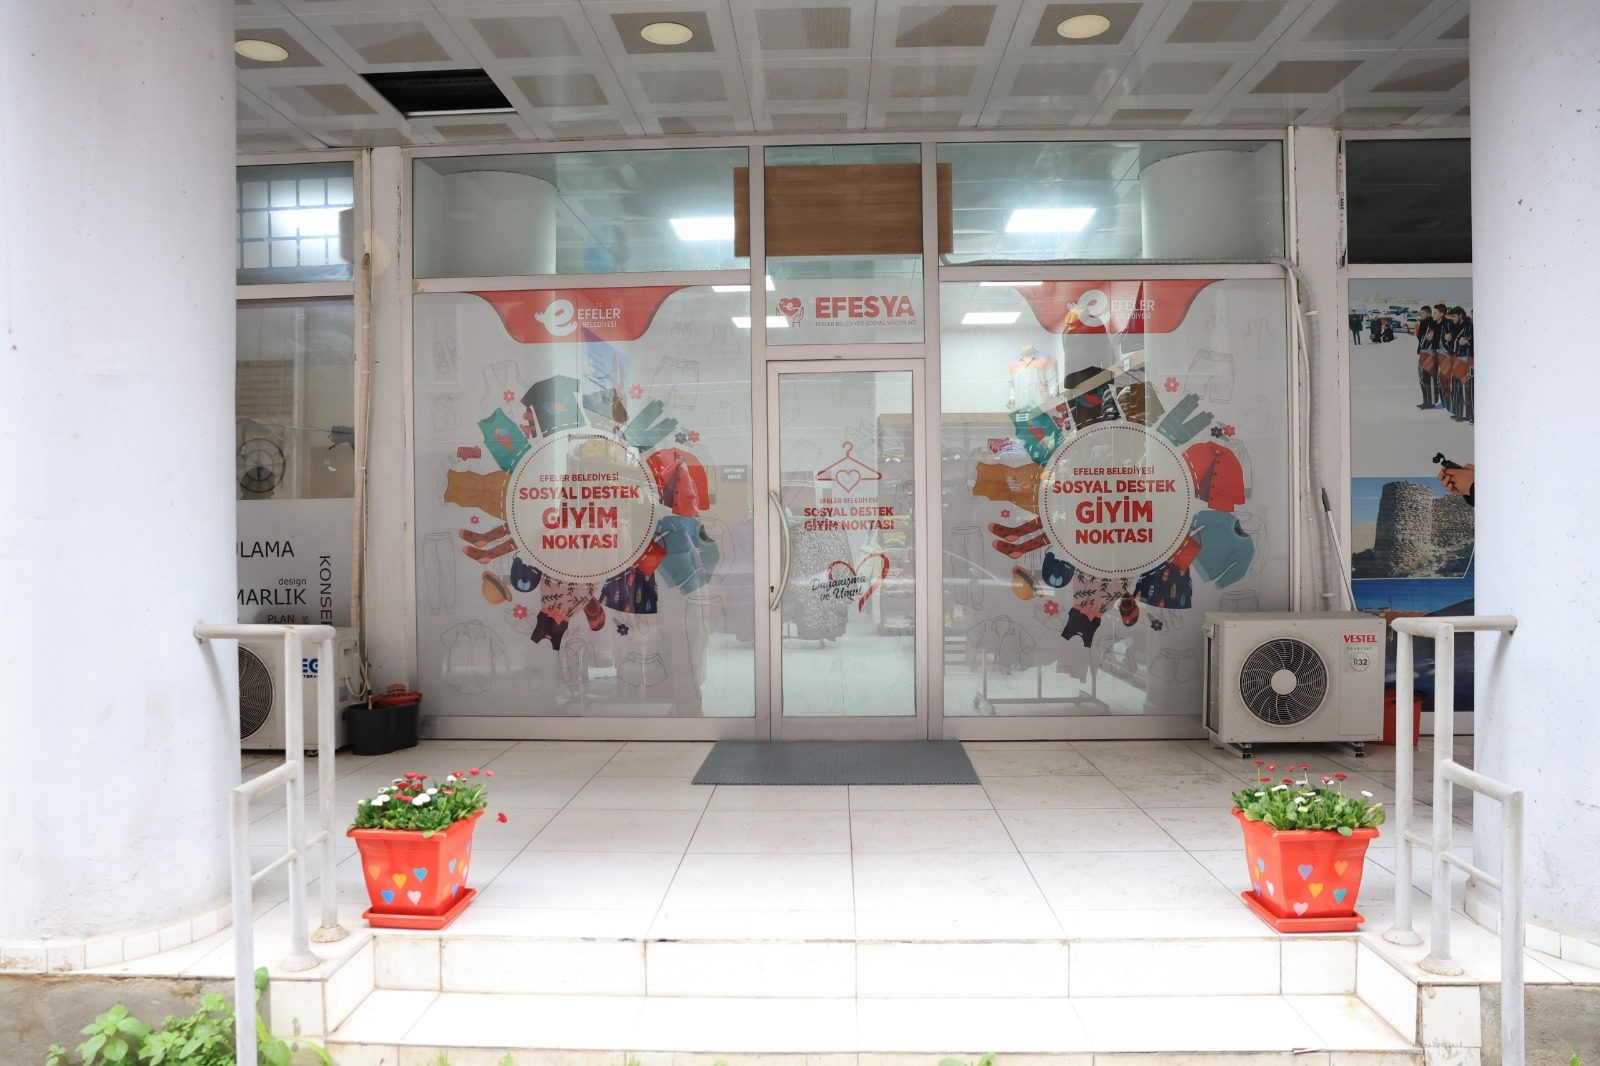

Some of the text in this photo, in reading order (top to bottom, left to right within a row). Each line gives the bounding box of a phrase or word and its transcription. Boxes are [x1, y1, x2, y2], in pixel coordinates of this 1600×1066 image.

[815, 295, 915, 318] EFESYA
[1111, 299, 1156, 311] EFELER
[577, 307, 621, 320] EFELER
[539, 471, 619, 482] EFELER BELEDİYESİ
[1073, 465, 1154, 476] EFELER BELEDİYESİ
[519, 485, 640, 500] SOSYAL DESTEK
[1052, 479, 1176, 494] SOSYAL DESTEK
[542, 502, 618, 530] GİYİM
[803, 506, 894, 517] SOSYAL DESTEK
[1075, 495, 1153, 524] GİYİM
[803, 518, 895, 532] GİYİM NOKTASI
[542, 533, 618, 550] NOKTASI
[1075, 528, 1153, 545] NOKTASI
[236, 541, 295, 558] LAMA
[278, 577, 307, 588] design
[819, 594, 832, 602] ve
[267, 614, 295, 624] PLAN
[1343, 634, 1378, 643] VESTEL
[1353, 658, 1368, 666] R32
